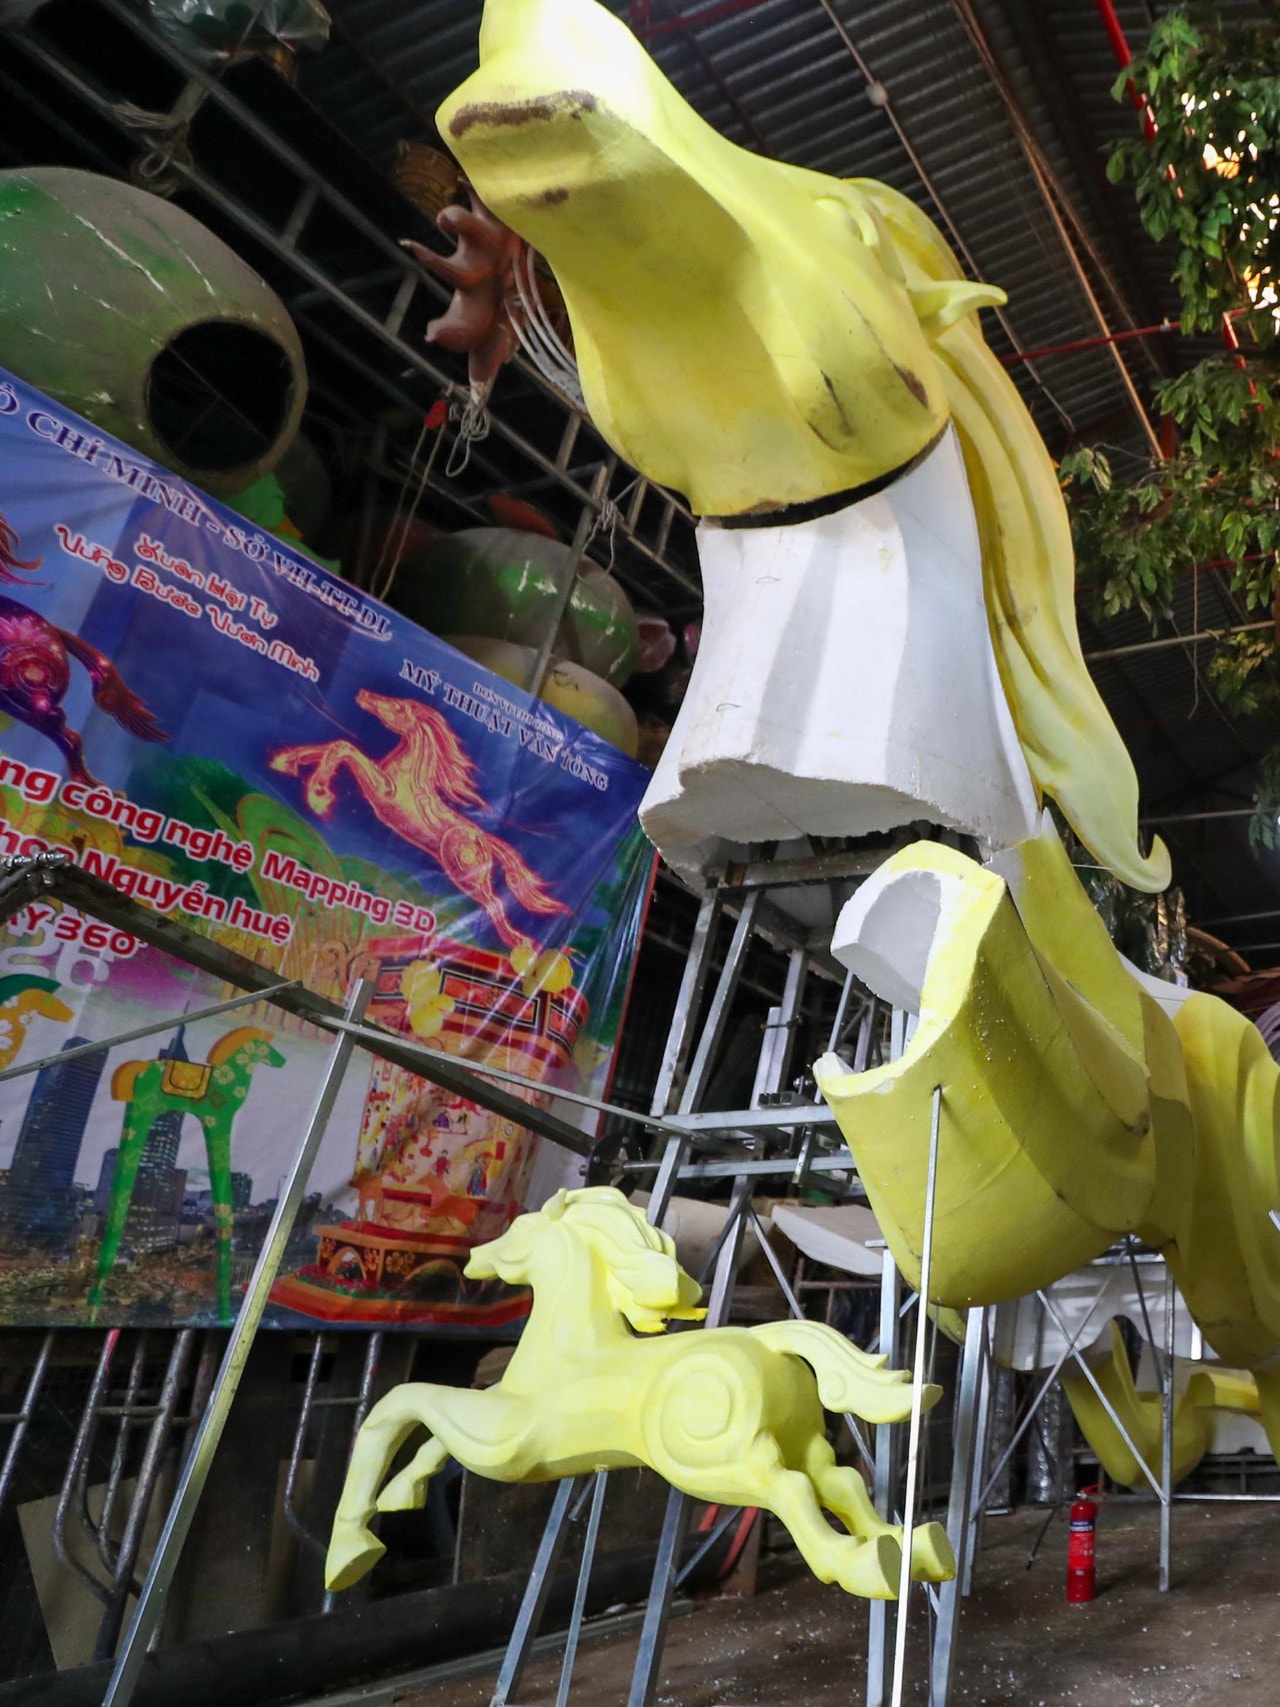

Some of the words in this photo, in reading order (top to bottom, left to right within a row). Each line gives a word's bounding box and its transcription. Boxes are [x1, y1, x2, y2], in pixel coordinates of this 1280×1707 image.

[27, 410, 104, 465] CHÍ
[103, 453, 207, 527] MINH
[223, 524, 270, 561] SỞ
[53, 524, 129, 582] Vững
[206, 605, 267, 654] Vươn
[134, 533, 203, 588] Xuân
[206, 574, 247, 611] Hội
[251, 596, 278, 629] Tụ
[399, 658, 441, 694] MỸ
[443, 683, 515, 737] THUẬT
[518, 728, 558, 763] VĂN
[60, 780, 165, 843] công
[164, 818, 254, 873] nghệ
[260, 850, 391, 924] Mapping
[393, 900, 436, 934] 3D
[81, 851, 228, 921] Nguyễn
[229, 896, 291, 945] huệ
